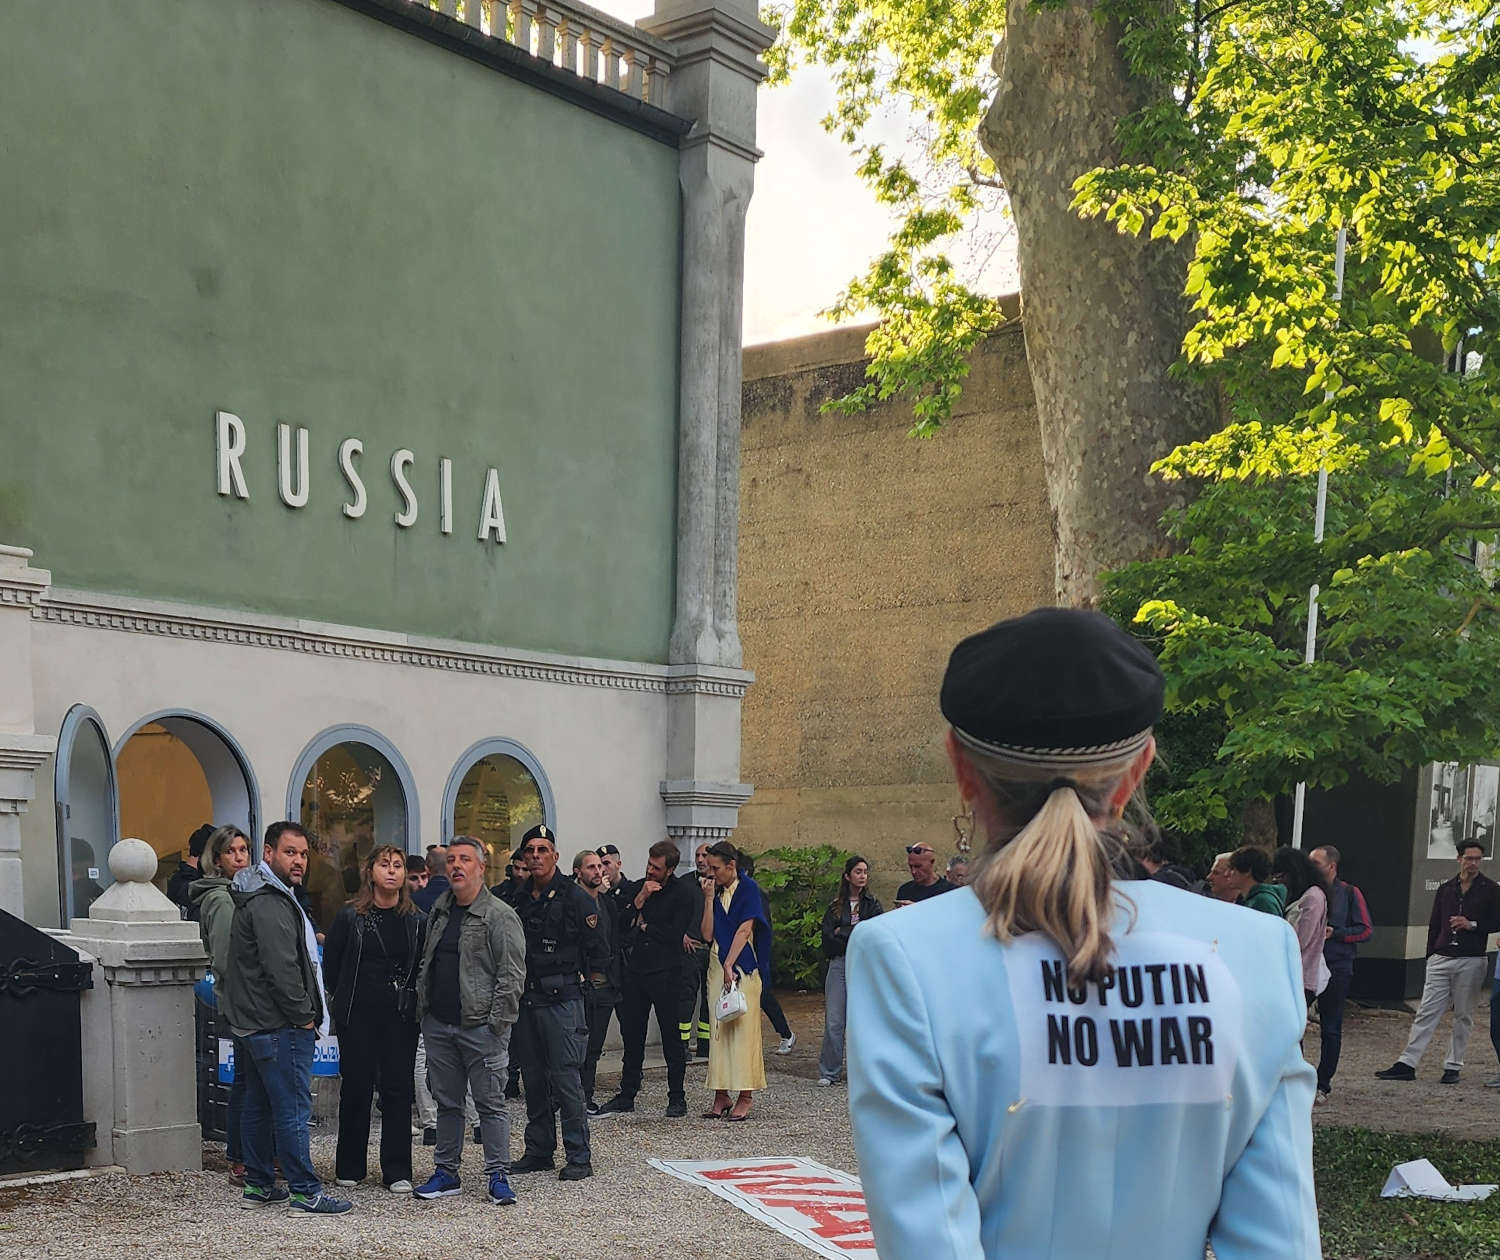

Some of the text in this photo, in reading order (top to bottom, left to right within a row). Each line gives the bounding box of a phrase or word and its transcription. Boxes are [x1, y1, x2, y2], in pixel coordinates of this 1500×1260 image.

[215, 410, 507, 544] RUSSIA
[1098, 963, 1210, 1008] PUTIN
[1047, 1013, 1215, 1067] NO WAR
